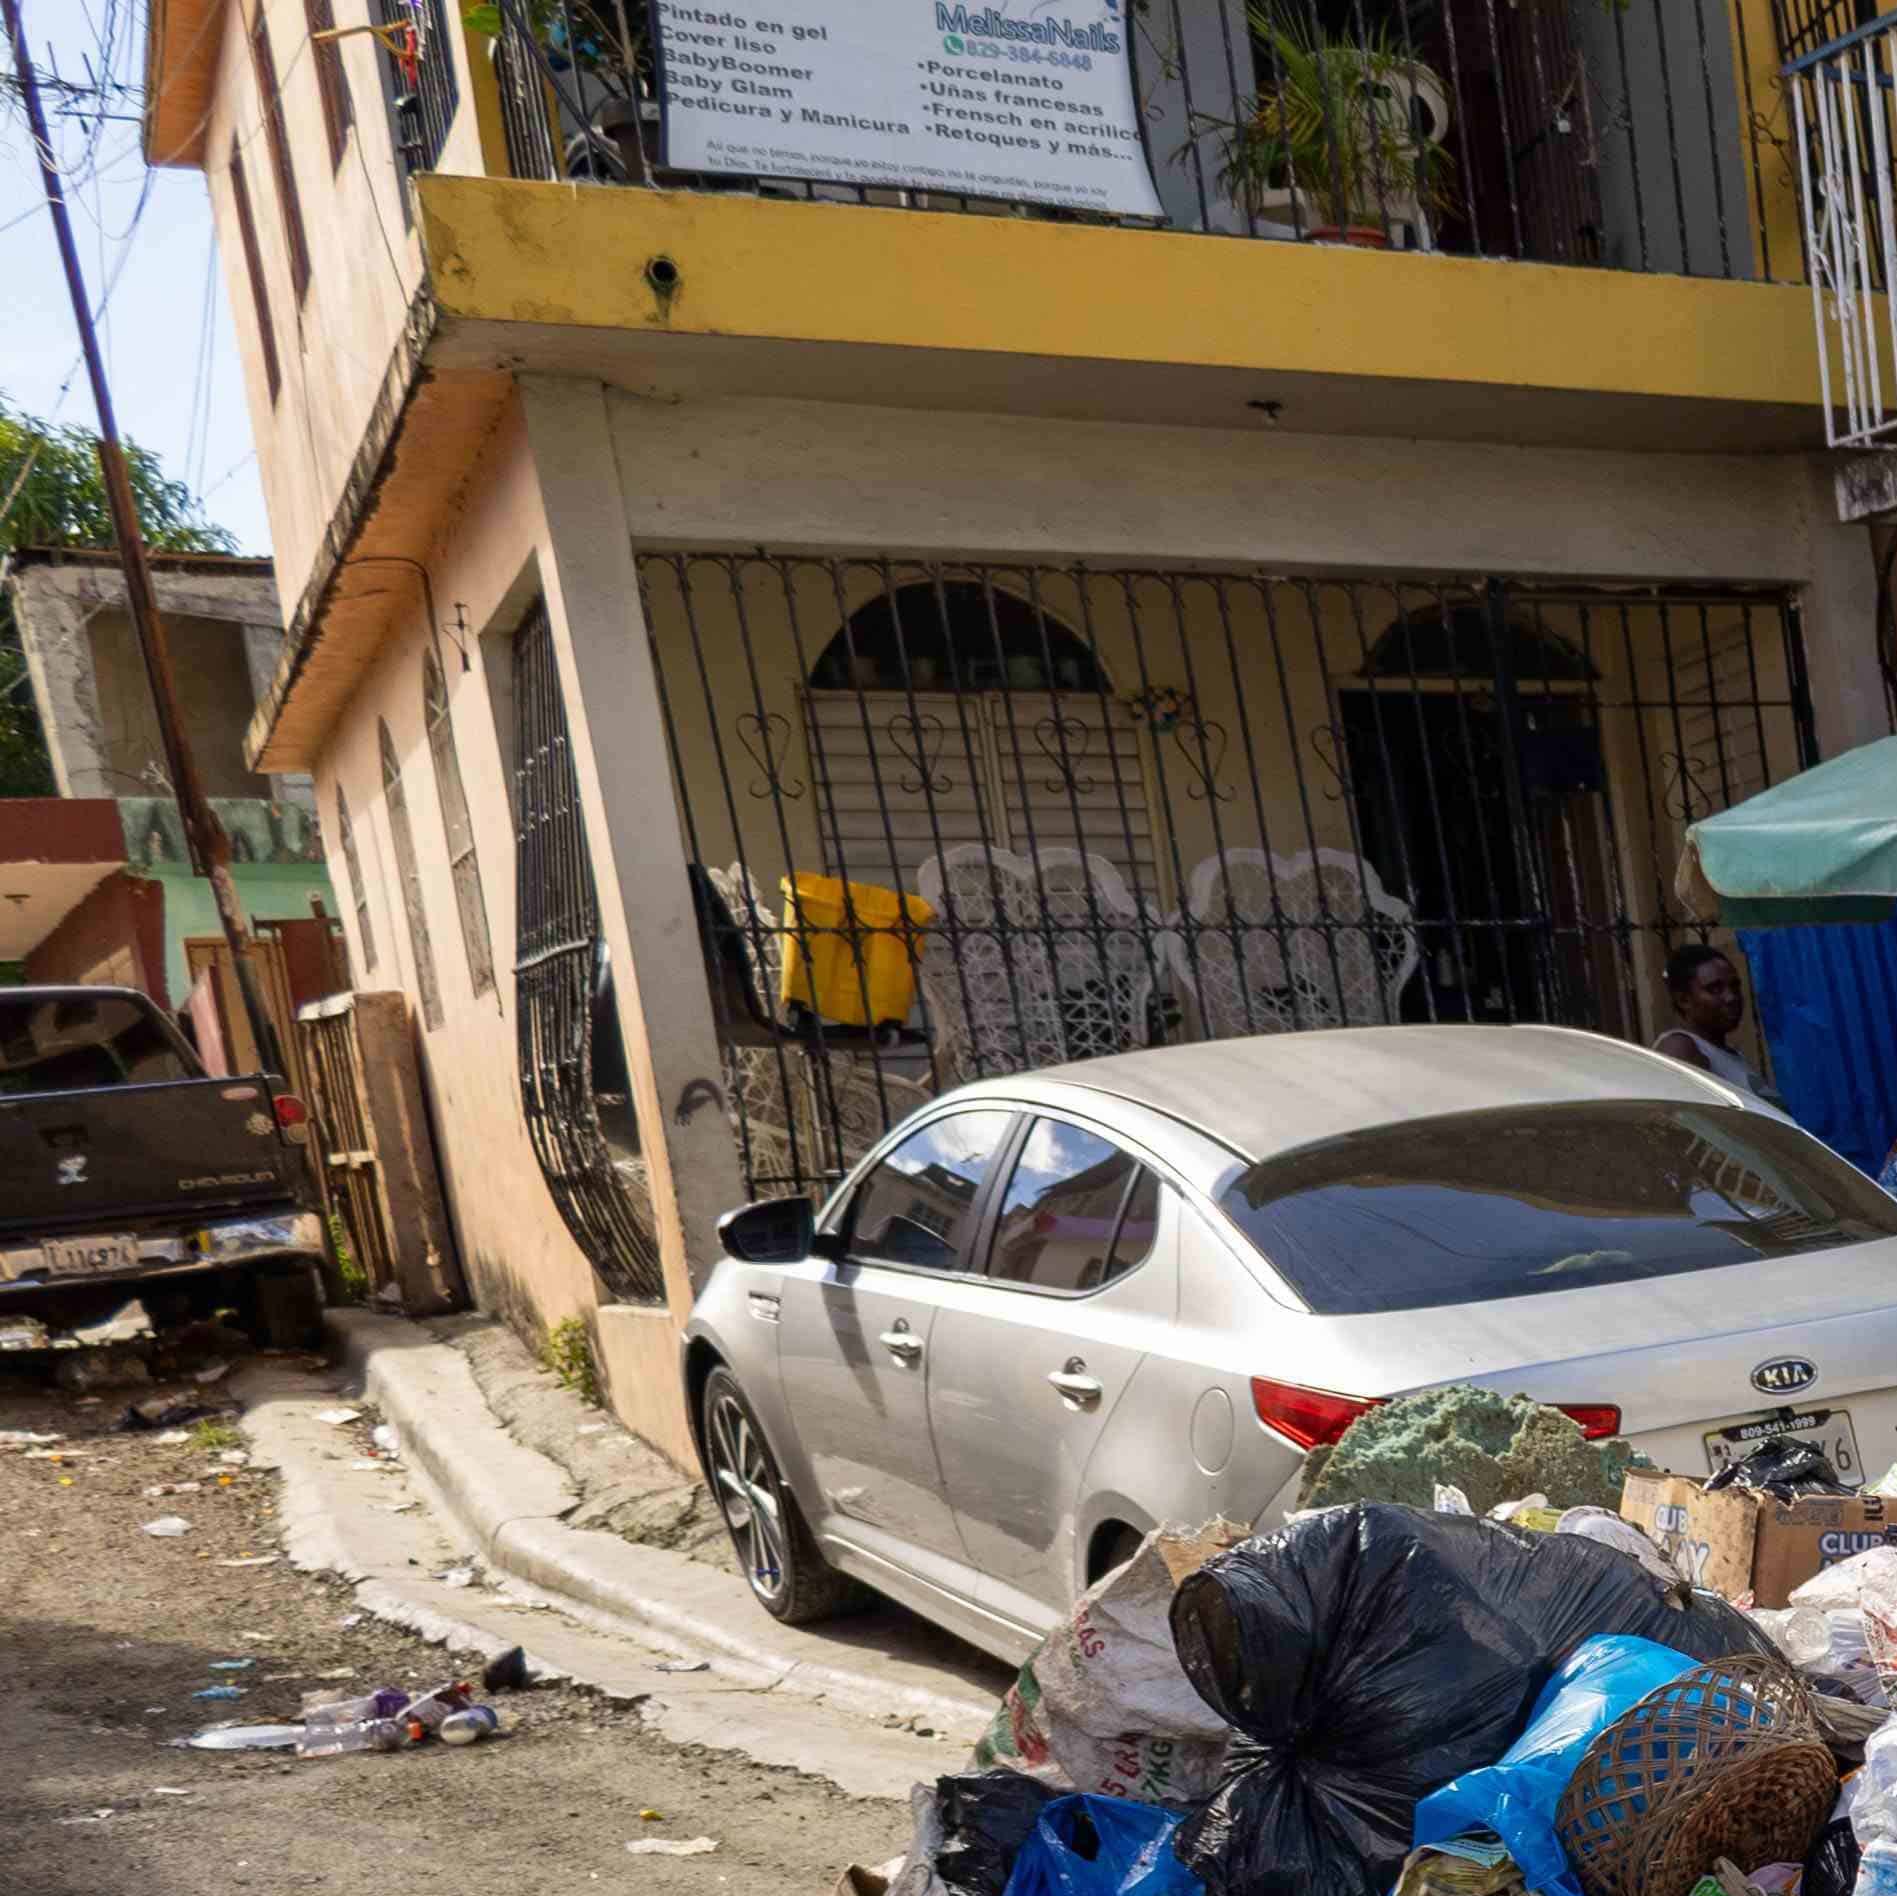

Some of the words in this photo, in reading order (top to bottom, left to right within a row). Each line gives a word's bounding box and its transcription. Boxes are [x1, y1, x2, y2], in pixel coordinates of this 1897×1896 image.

[657, 2, 747, 31] Pintado
[755, 18, 783, 35] en
[791, 25, 828, 42] gel
[935, 1, 1121, 54] MelissaNails
[661, 24, 726, 48] Cover
[734, 35, 777, 55] liso
[663, 48, 815, 81] BabyBoomer
[926, 60, 1064, 91] Porcelanato
[665, 70, 723, 94] Baby
[731, 77, 793, 99] Glam
[930, 80, 987, 103] Uñas
[994, 90, 1104, 117] francesas
[667, 92, 772, 118] Pedicura
[781, 107, 793, 123] y
[801, 107, 911, 135] Manicura
[933, 102, 1023, 128] Frensch
[1030, 116, 1057, 132] en
[935, 122, 1041, 151] Retoques
[1049, 139, 1061, 155] y
[1764, 1364, 1808, 1388] KIA
[1740, 1415, 1816, 1440] 809-541-1999
[1819, 1531, 1885, 1555] CLUB
